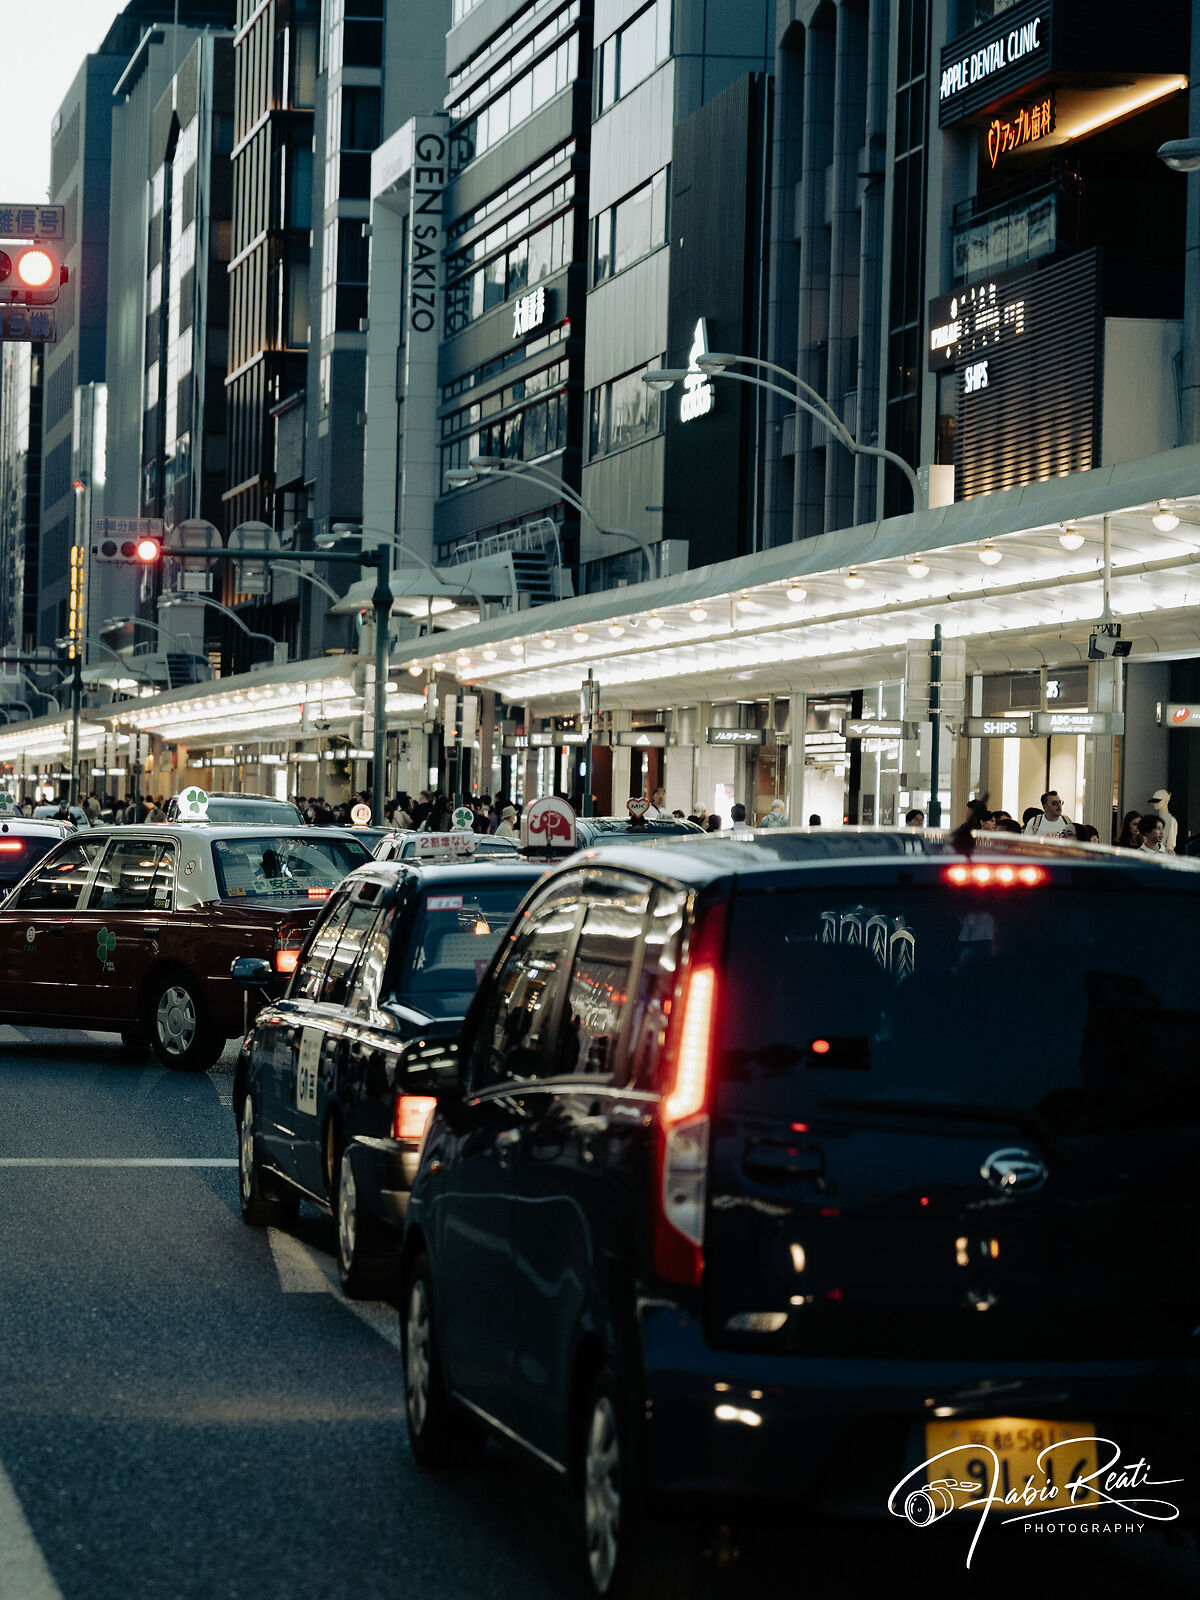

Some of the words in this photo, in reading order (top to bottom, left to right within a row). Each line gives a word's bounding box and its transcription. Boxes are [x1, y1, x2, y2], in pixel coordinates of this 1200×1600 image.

[940, 57, 968, 99] APPLE
[971, 38, 1006, 81] DENTAL
[1008, 17, 1041, 62] CLINIC
[1002, 99, 1051, 152] アップル歯科
[416, 133, 445, 214] GEN
[411, 225, 437, 332] SAKIZO
[965, 360, 988, 393] SHIPS
[983, 721, 1017, 734] SHIPS
[420, 835, 470, 848] 2割増なし
